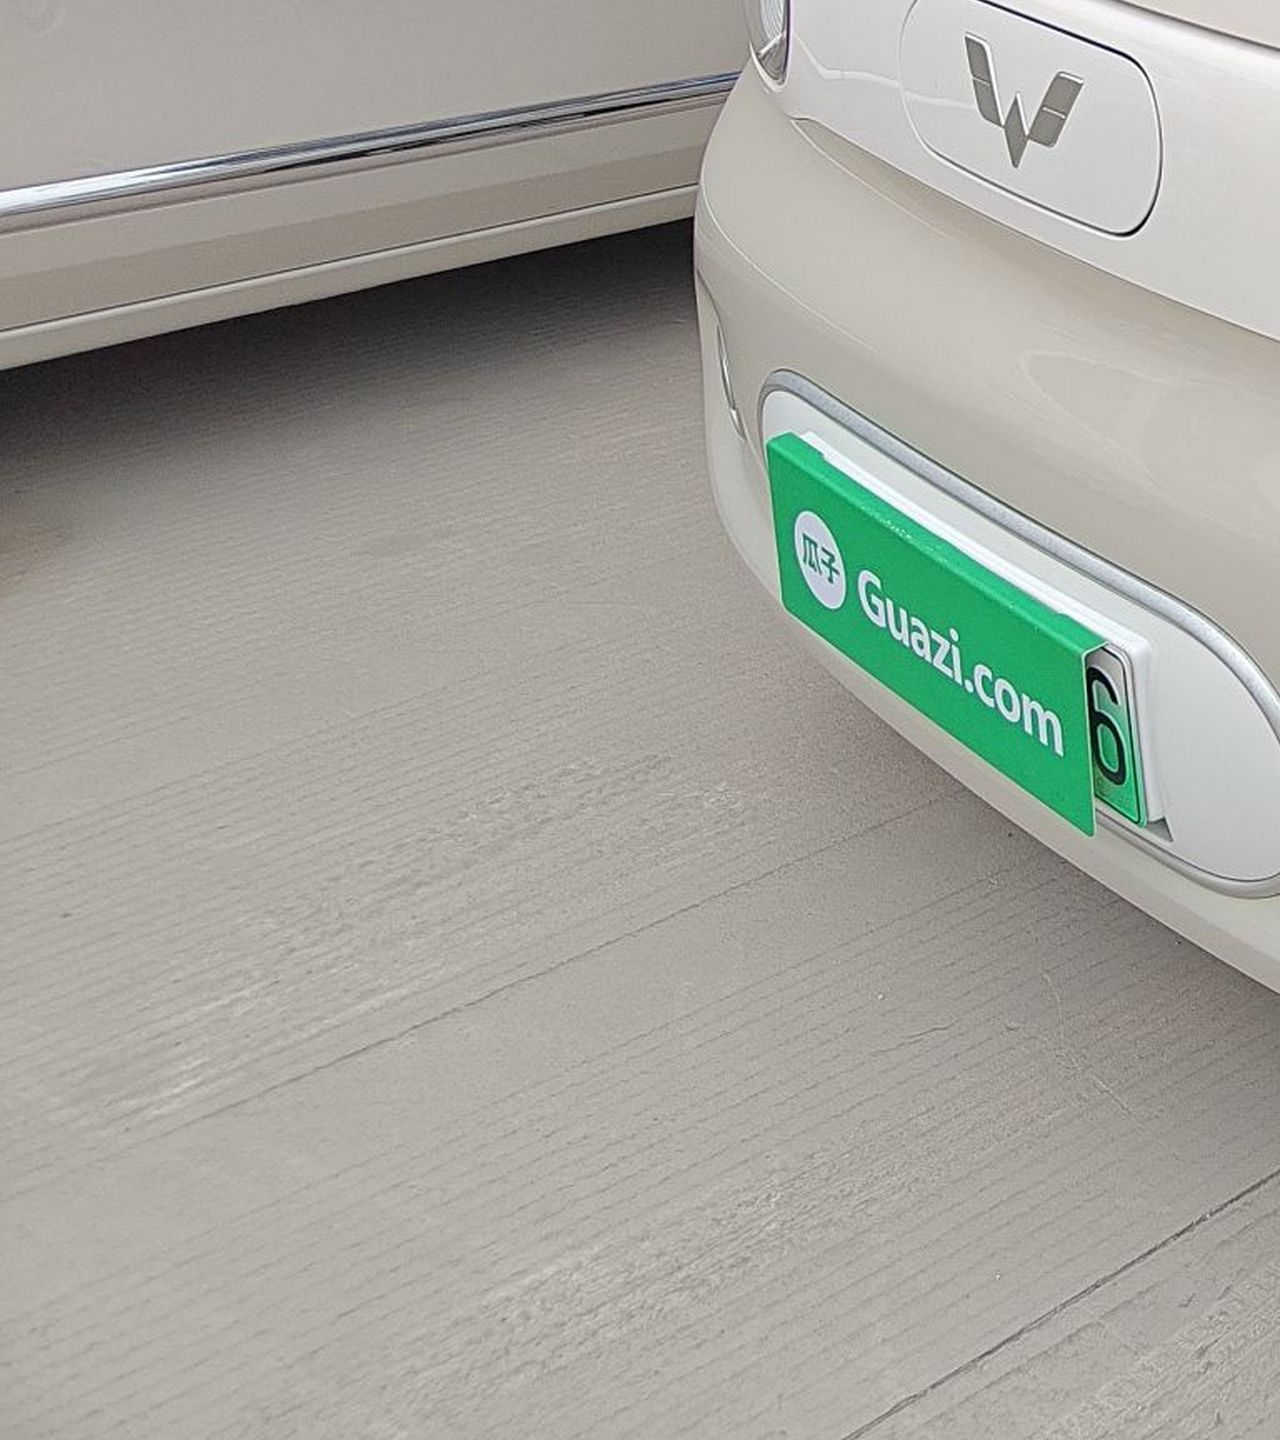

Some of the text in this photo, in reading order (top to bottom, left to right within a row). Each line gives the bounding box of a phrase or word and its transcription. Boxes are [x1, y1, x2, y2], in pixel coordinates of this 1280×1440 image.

[801, 532, 842, 584] 瓜子
[856, 568, 1065, 758] Guazi.com
[1086, 665, 1127, 786] 6
